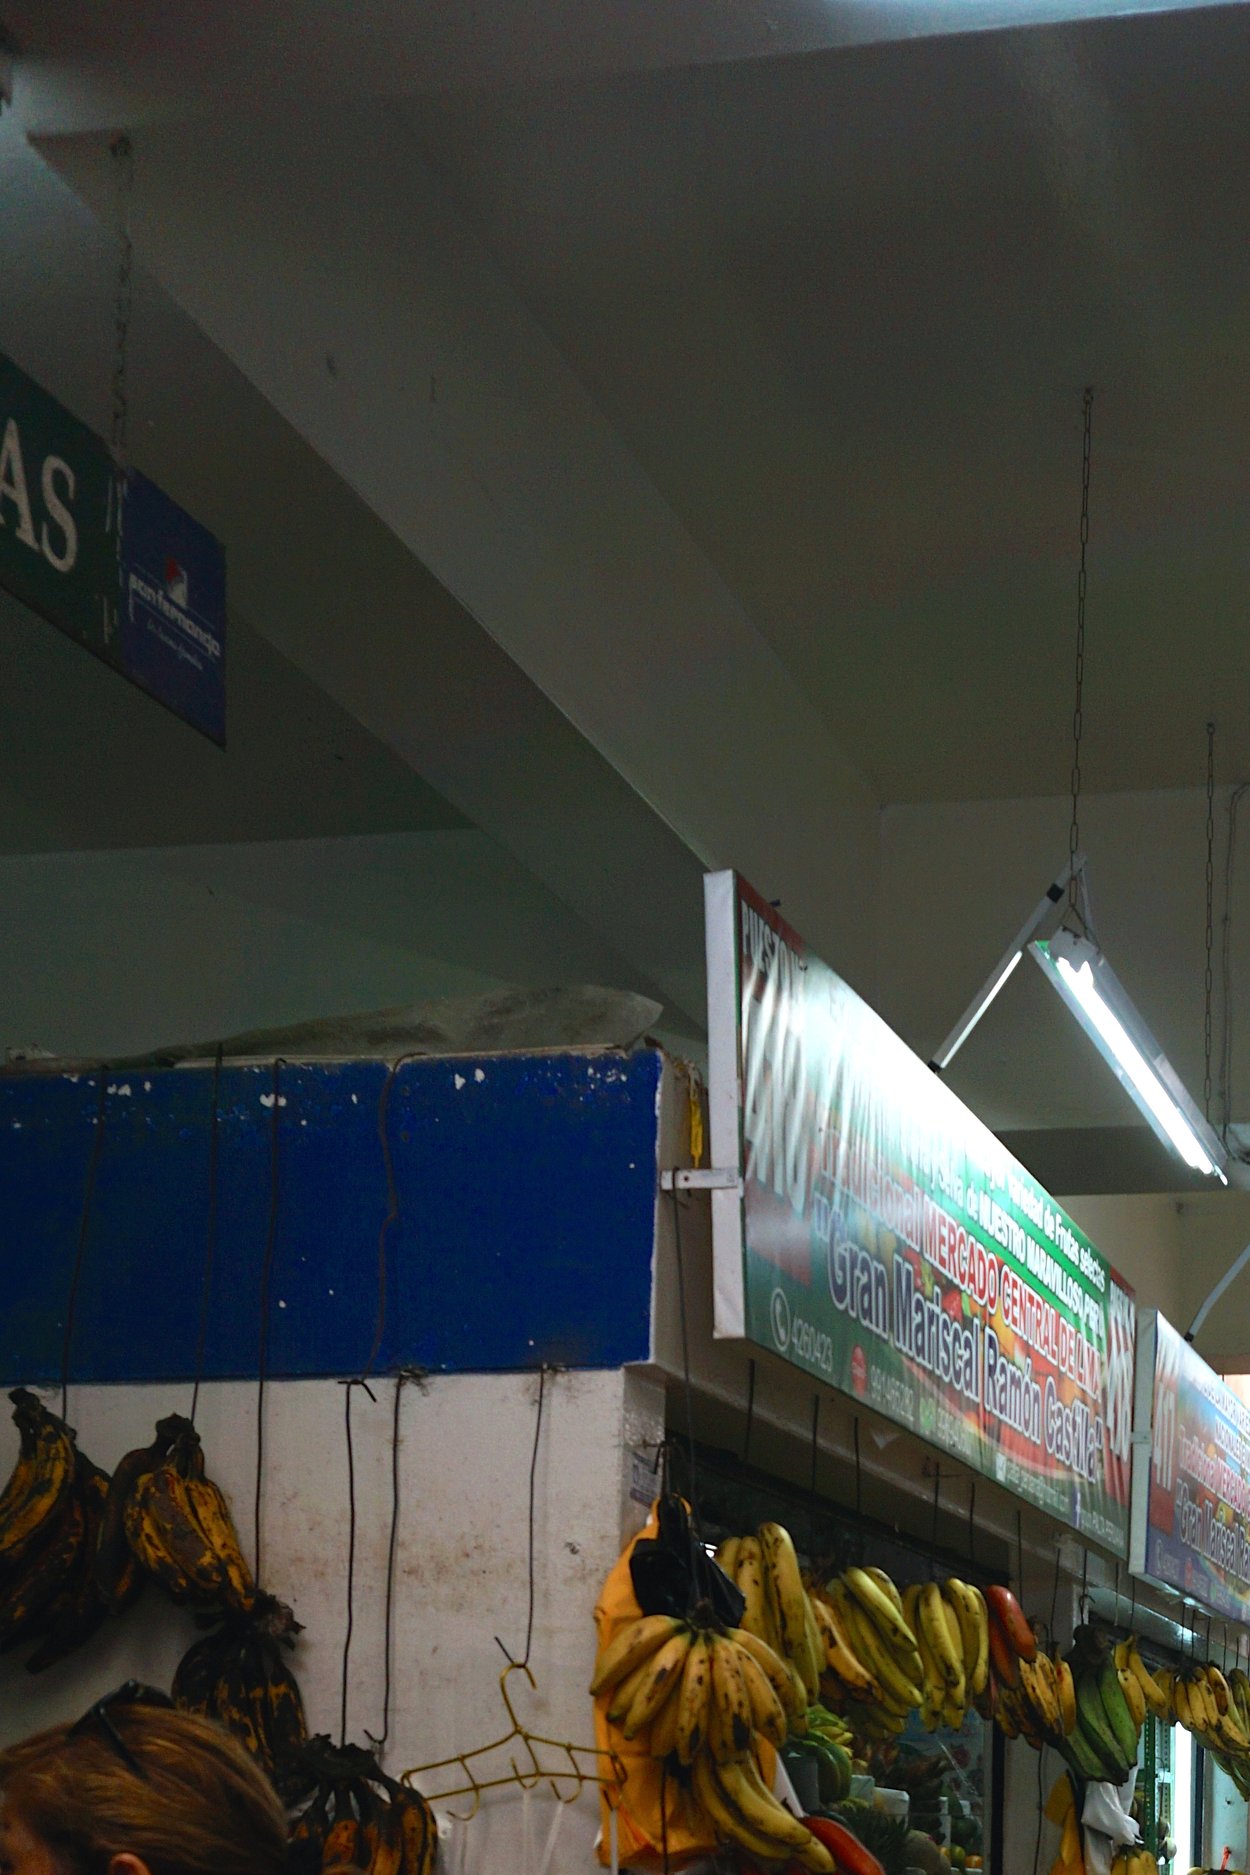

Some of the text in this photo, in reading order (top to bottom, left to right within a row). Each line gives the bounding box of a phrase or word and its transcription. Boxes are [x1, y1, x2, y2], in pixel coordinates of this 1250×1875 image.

[922, 1192, 999, 1319] MERCADO
[1000, 1263, 1059, 1368] CENTRAL
[1058, 1316, 1076, 1379] DE
[979, 1188, 1025, 1267] NUESTRO
[1026, 1234, 1084, 1321] MARAVILLOSO
[1044, 1201, 1054, 1243] de
[1055, 1211, 1079, 1269] Frutas
[1079, 1238, 1105, 1295] selectas
[892, 1250, 980, 1405] Mariscal
[983, 1323, 1042, 1446] Ramón
[1152, 1377, 1176, 1495] 417
[1202, 1495, 1238, 1578] Mariscal
